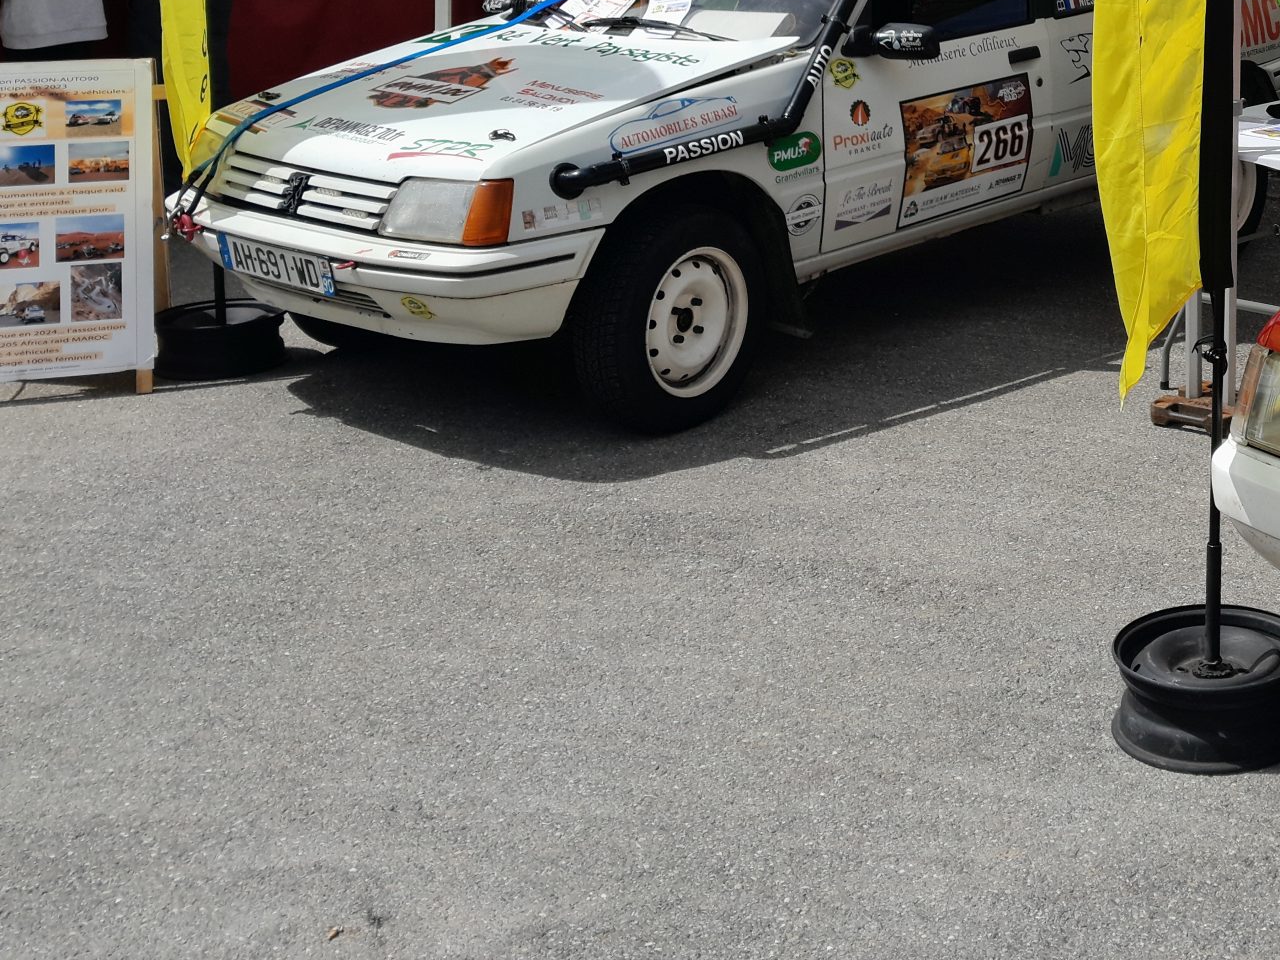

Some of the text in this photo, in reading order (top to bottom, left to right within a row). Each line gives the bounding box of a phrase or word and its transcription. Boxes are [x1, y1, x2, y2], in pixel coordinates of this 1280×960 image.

[806, 44, 833, 89] AUTO
[14, 76, 100, 84] PASSION-AUTO90
[621, 104, 738, 150] AUTOMOBILES SUBASI
[663, 130, 744, 164] PASSION
[849, 143, 882, 156] FRANCE
[977, 121, 1025, 167] 266
[774, 146, 799, 164] PMU
[775, 165, 820, 184] Grandvillars
[0, 190, 56, 199] humanitaire
[30, 199, 71, 207] entraide
[51, 208, 87, 216] chaque
[323, 278, 335, 294] 90
[67, 324, 126, 334] l'association
[20, 338, 48, 346] Africa
[71, 334, 109, 342] MAROC
[14, 348, 60, 356] véhicules
[55, 354, 92, 362] féminin
